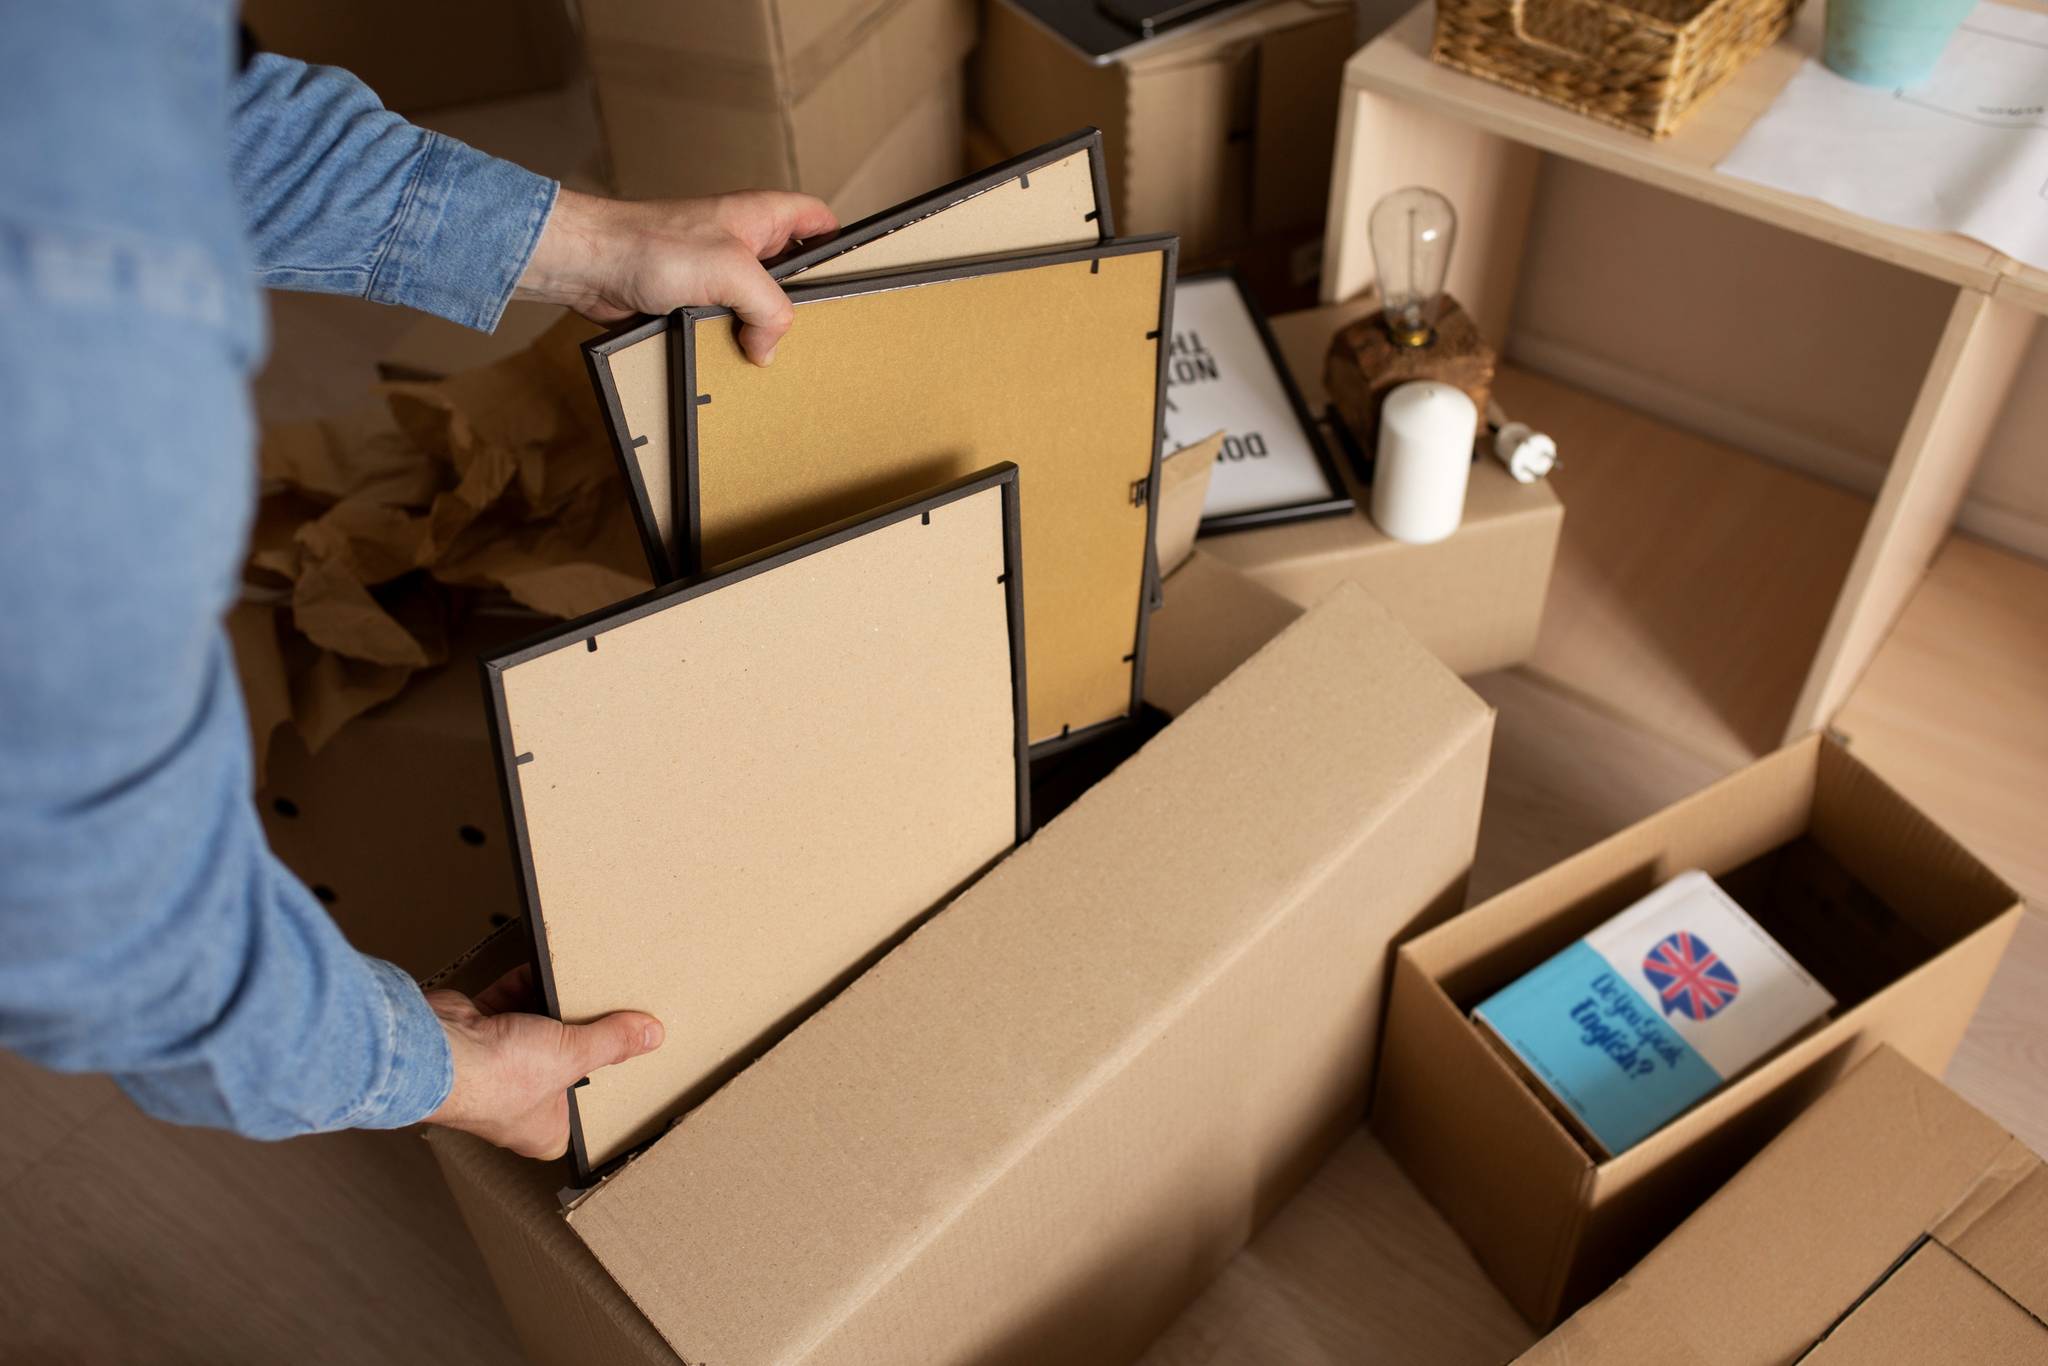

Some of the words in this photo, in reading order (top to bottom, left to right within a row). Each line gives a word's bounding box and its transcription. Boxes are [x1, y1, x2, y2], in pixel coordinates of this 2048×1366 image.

[1216, 431, 1268, 462] DO
[1590, 972, 1618, 1000] Do
[1569, 997, 1655, 1079] English?
